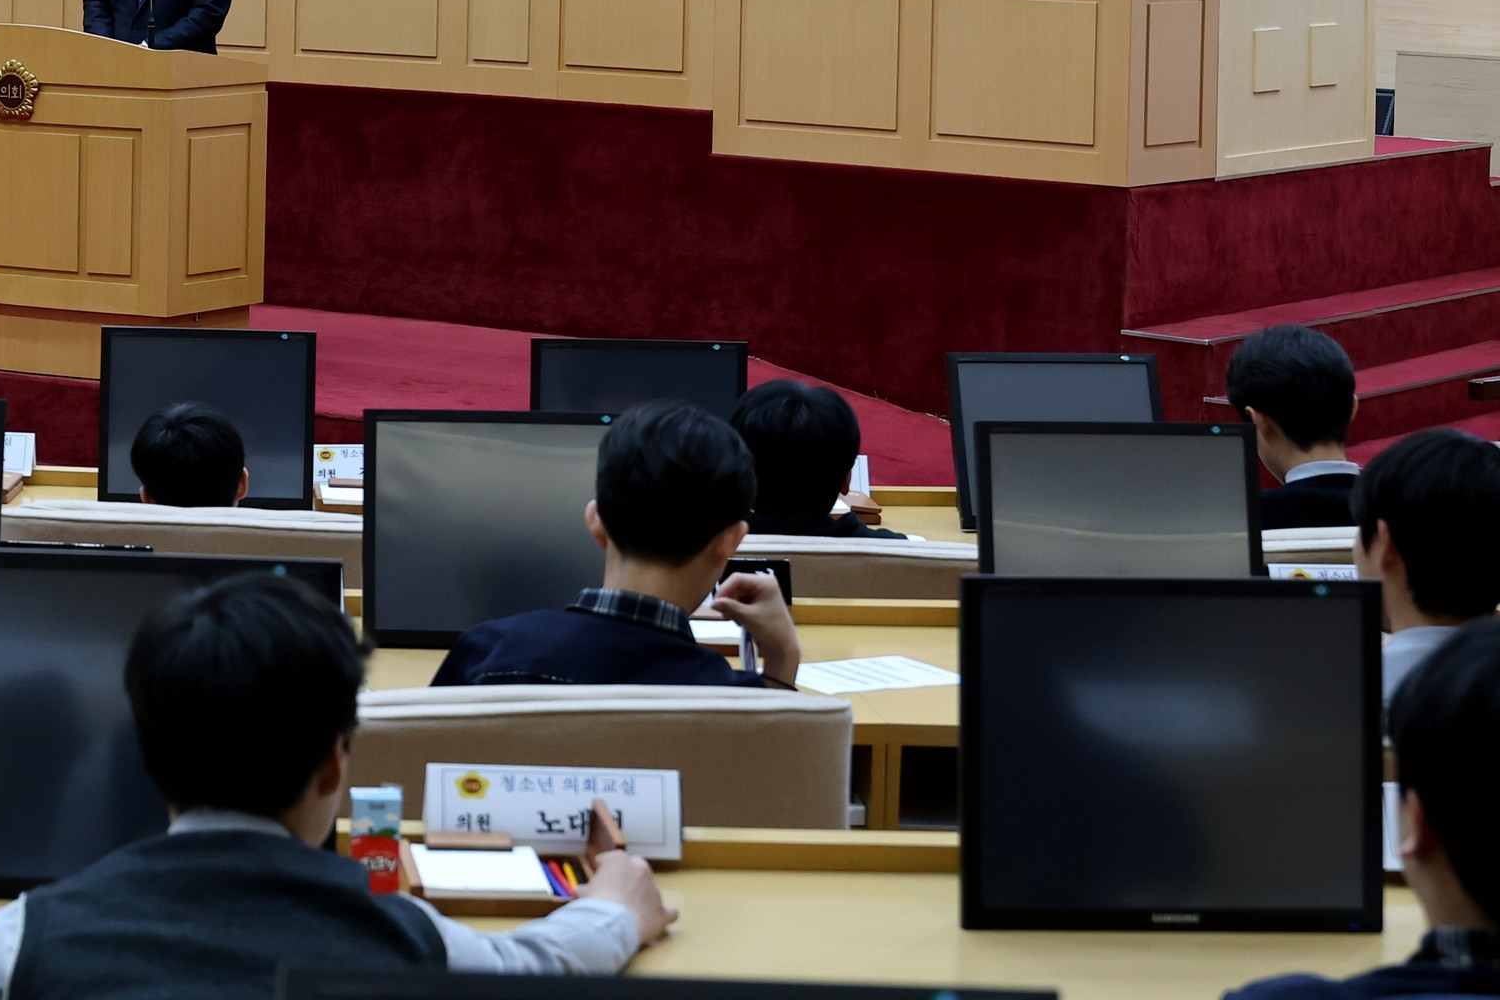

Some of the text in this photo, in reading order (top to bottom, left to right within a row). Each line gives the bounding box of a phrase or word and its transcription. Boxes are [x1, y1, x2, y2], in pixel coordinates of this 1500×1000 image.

[0, 83, 22, 99] 의회
[317, 469, 336, 479] 의원
[500, 774, 637, 797] 청소년 의회교실
[455, 810, 492, 832] 의원
